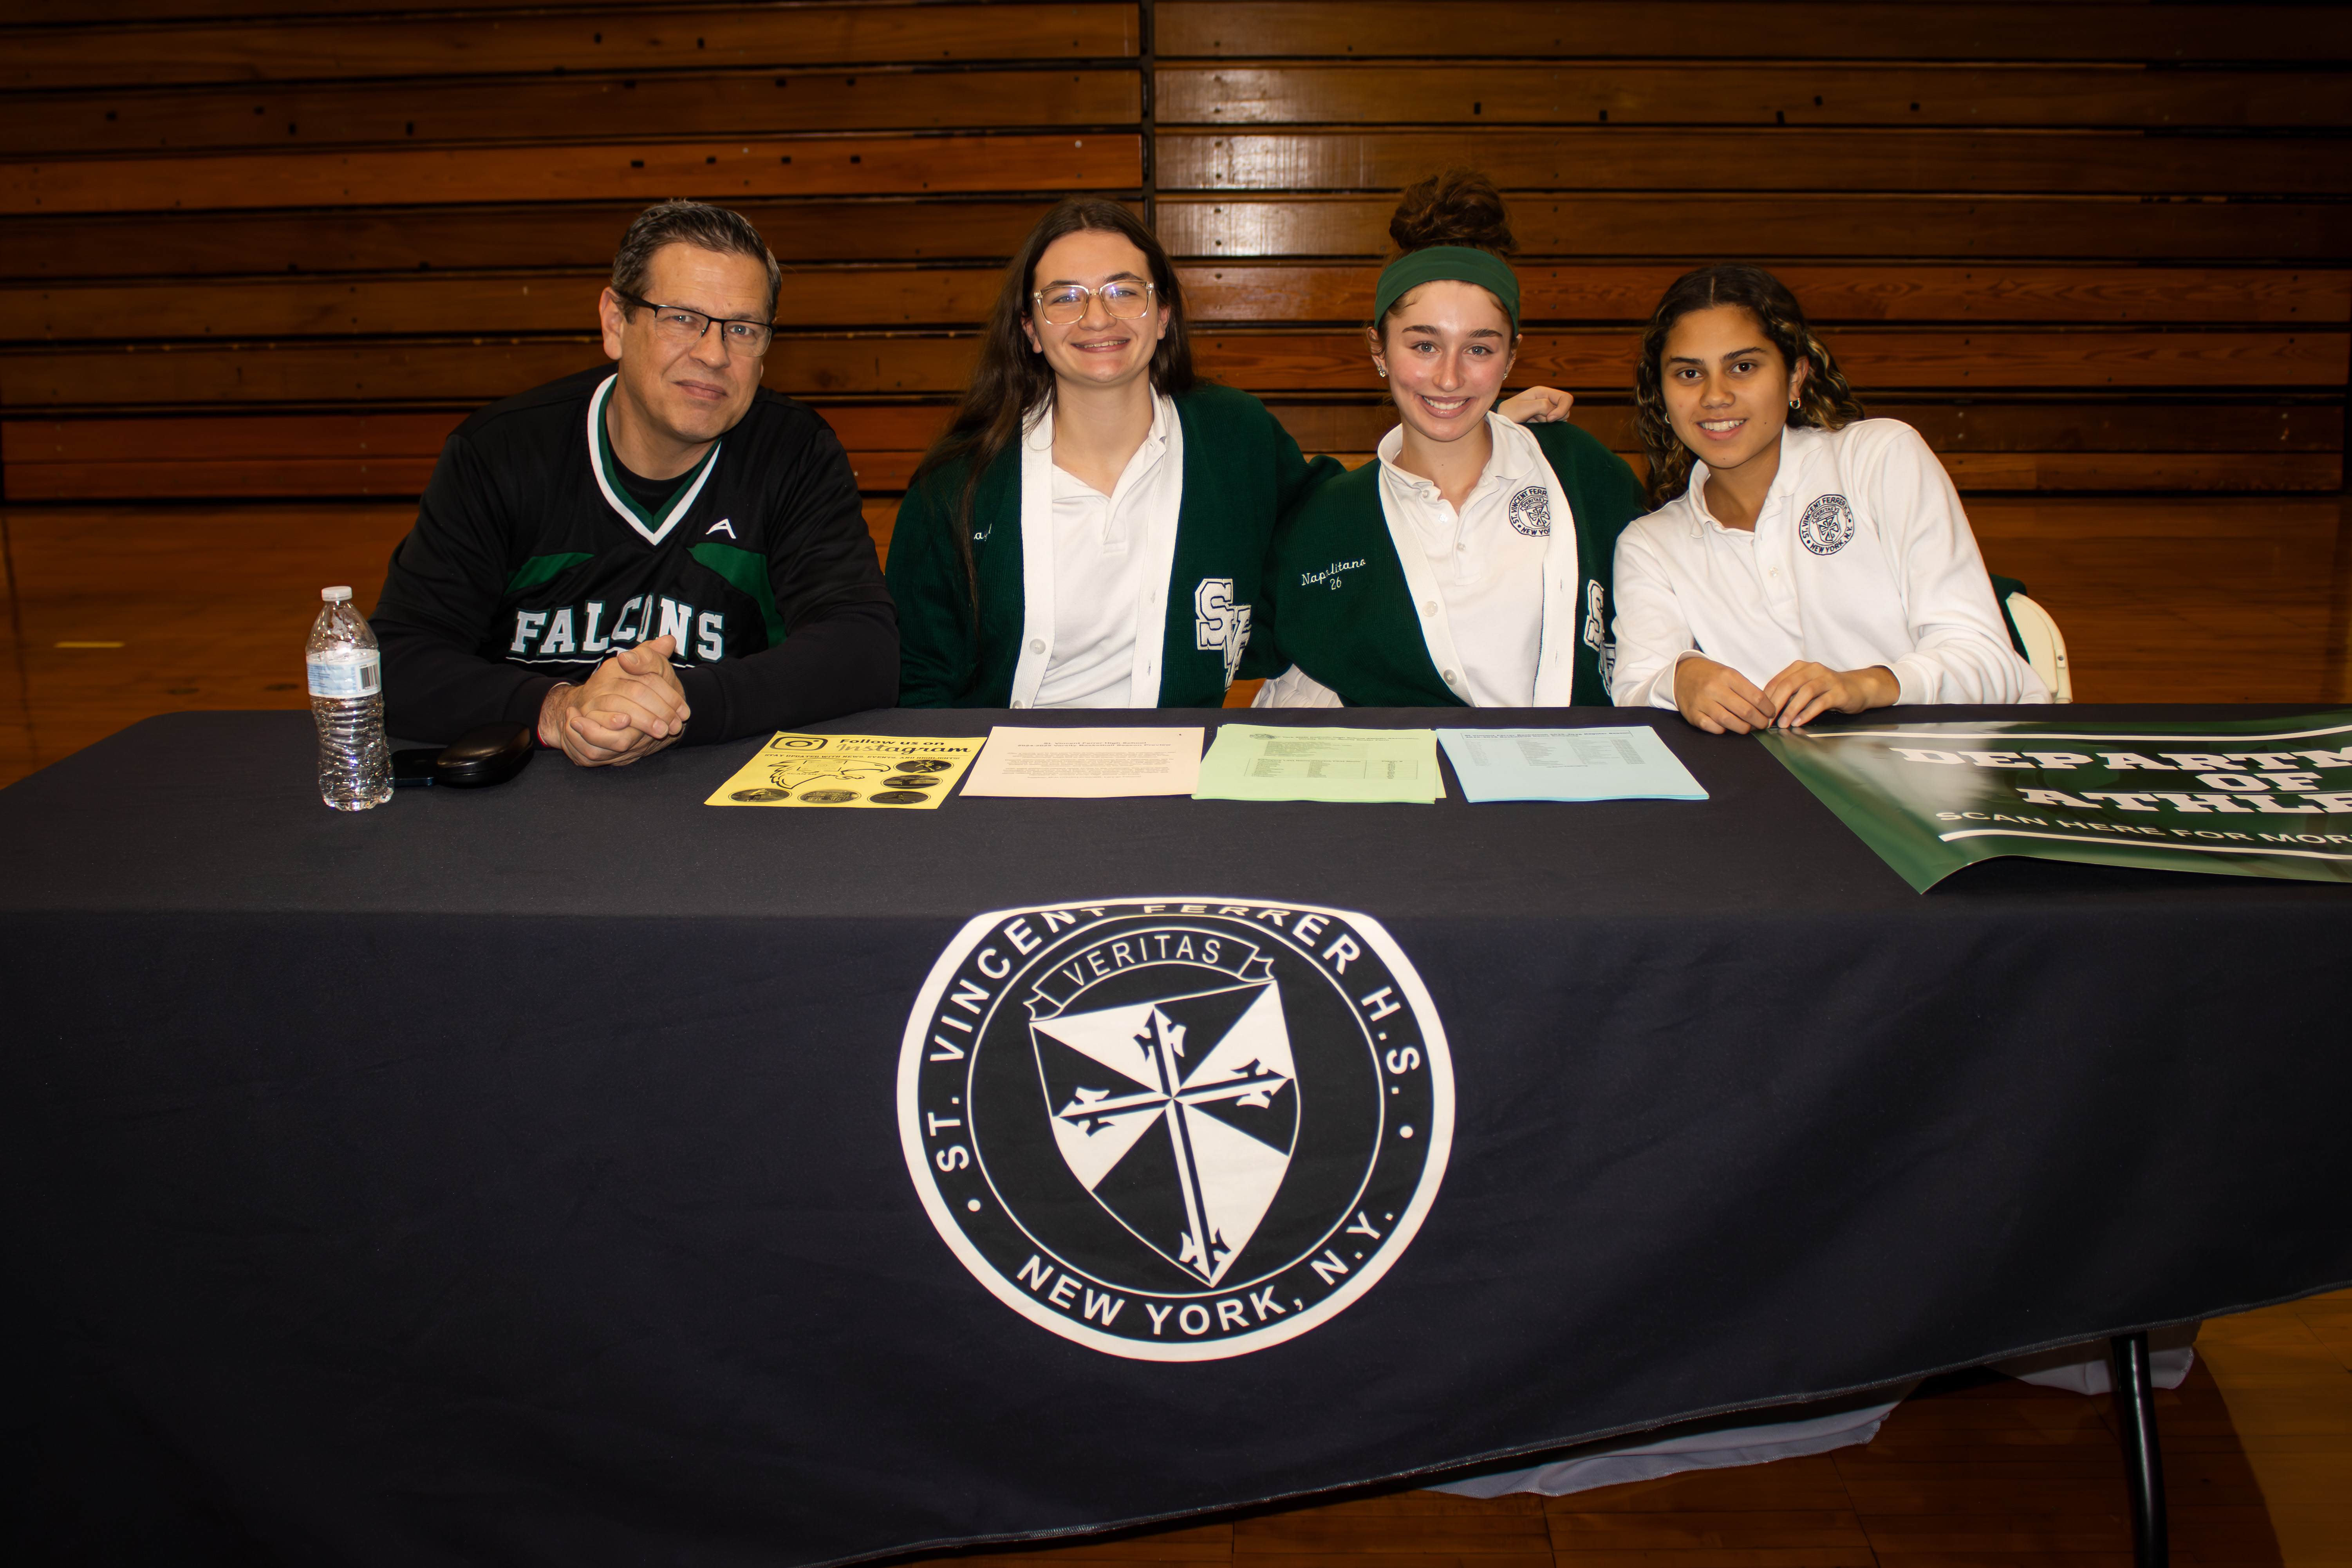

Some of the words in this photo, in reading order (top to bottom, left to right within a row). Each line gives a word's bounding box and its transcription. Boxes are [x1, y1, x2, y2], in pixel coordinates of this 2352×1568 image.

[1511, 491, 1528, 513] VINCENT
[1522, 498, 1542, 507] VERITAS
[1801, 500, 1821, 527] VINCENT
[1822, 497, 1846, 508] FERRER
[1814, 507, 1834, 518] VERITAS
[1511, 514, 1519, 524] ST.
[1521, 527, 1537, 535] NEW
[1810, 543, 1825, 553] NEW
[1826, 539, 1847, 553] YORK,
[1301, 559, 1366, 586] Napolitano
[1330, 576, 1342, 590] 26
[509, 594, 725, 663] FALCONS
[836, 744, 972, 755] Instagram
[2195, 772, 2323, 791] OF
[1935, 812, 2049, 826] SCAN
[2055, 820, 2167, 835] HERE
[2170, 829, 2255, 841] FOR
[2257, 833, 2352, 844] MOR
[1143, 905, 1360, 975] FERRER
[1063, 934, 1222, 988] VERITAS
[929, 907, 1106, 1064] VINCENT
[1361, 986, 1421, 1095] H.S.
[929, 1095, 968, 1173] ST.
[1016, 1254, 1125, 1326] NEW
[1145, 1293, 1304, 1337] YORK,
[1310, 1210, 1395, 1286] N.Y.
